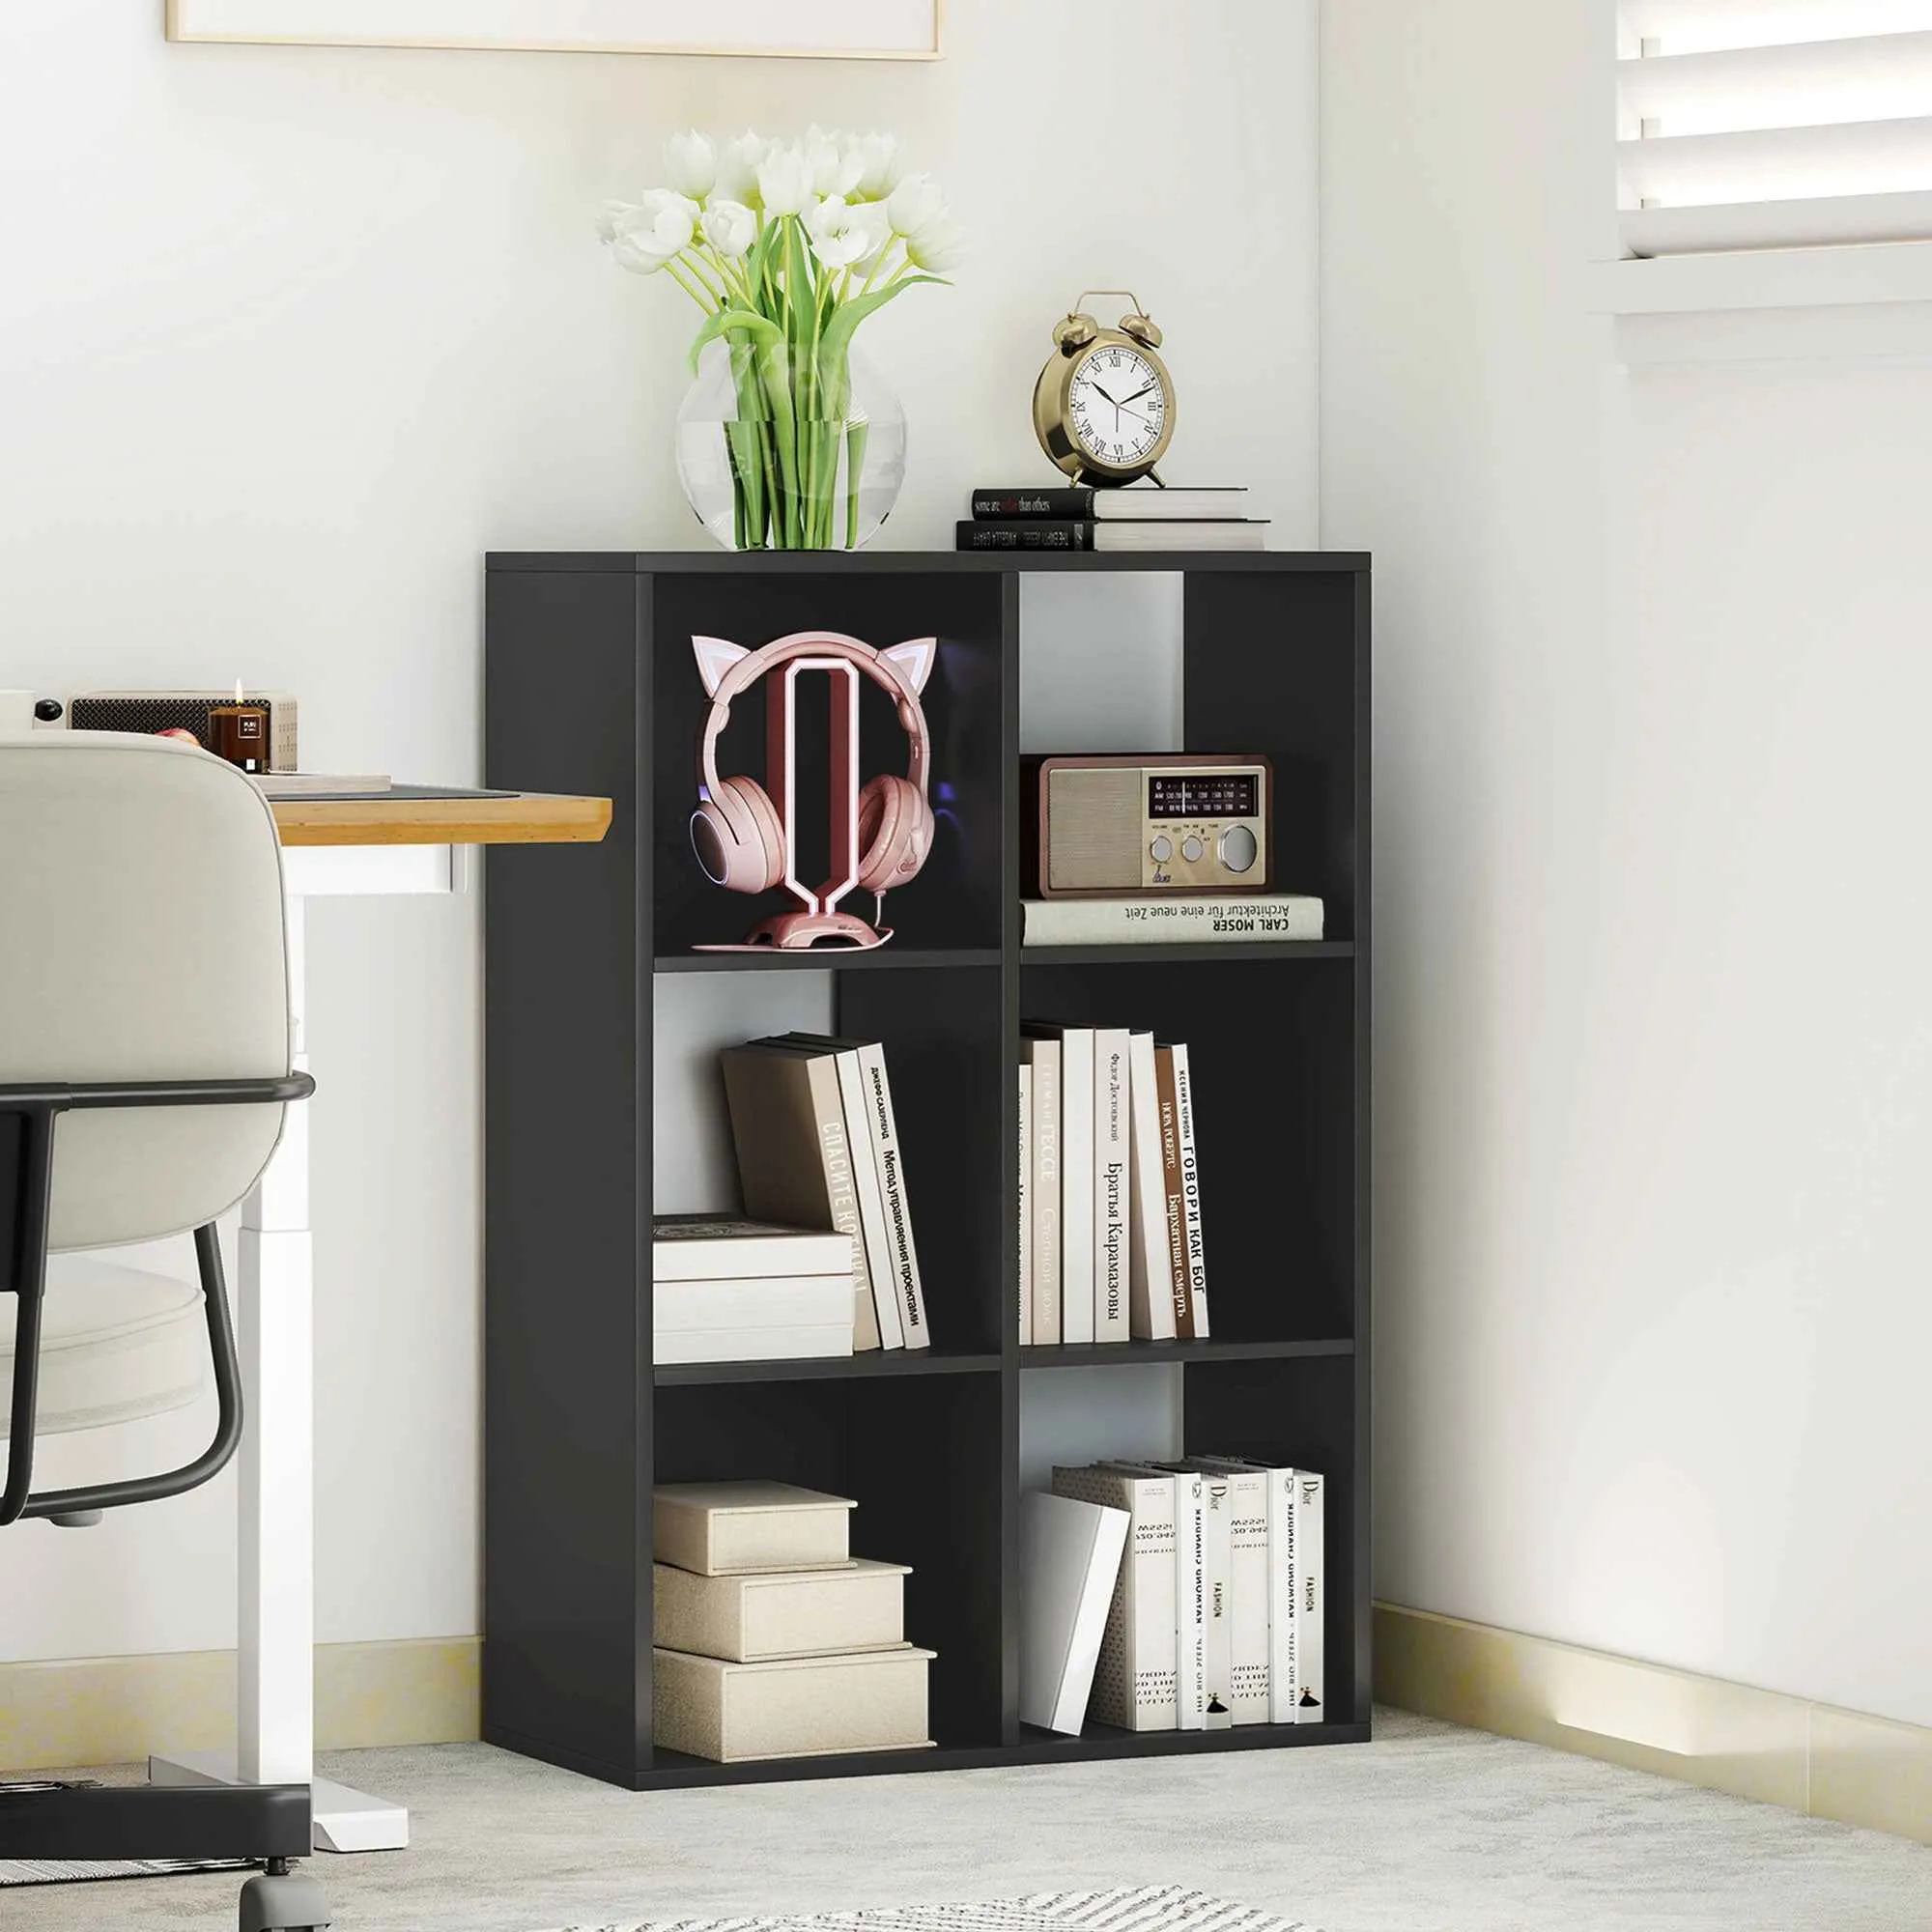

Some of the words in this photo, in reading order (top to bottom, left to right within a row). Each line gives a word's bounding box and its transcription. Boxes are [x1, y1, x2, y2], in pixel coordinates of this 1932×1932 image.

[1109, 355, 1121, 367] XII
[1130, 363, 1136, 373] I
[1142, 379, 1151, 388] II
[1076, 401, 1086, 412] IX
[1148, 401, 1156, 412] III
[1081, 418, 1094, 438] VIII
[1094, 436, 1107, 452] VII
[1113, 443, 1123, 456] VI
[1131, 437, 1140, 449] V
[1124, 907, 1148, 921] Zeit
[1150, 906, 1178, 917] neue
[1180, 905, 1205, 917] eine
[1207, 905, 1224, 920] für
[1227, 904, 1290, 918] Architektur
[1212, 919, 1254, 932] MOSER
[1259, 918, 1289, 931] CARL
[1040, 1123, 1056, 1182] ГЕССЕ
[823, 1122, 853, 1207] СПАСИТЕ
[1103, 1162, 1122, 1218] Братья
[1183, 1147, 1199, 1222] ГОВОРИ
[883, 1150, 896, 1190] Метод
[900, 1263, 920, 1326] проектами
[1167, 1193, 1182, 1267] Бархатная
[1189, 1229, 1202, 1260] КАК
[1103, 1222, 1123, 1321] Карамазовы
[1192, 1265, 1206, 1294] БОГ
[1173, 1269, 1186, 1318] смерть
[1209, 1485, 1227, 1511] Dior
[1302, 1481, 1320, 1506] Dior
[1212, 1581, 1223, 1618] FASHION
[1305, 1577, 1316, 1612] FASHION
